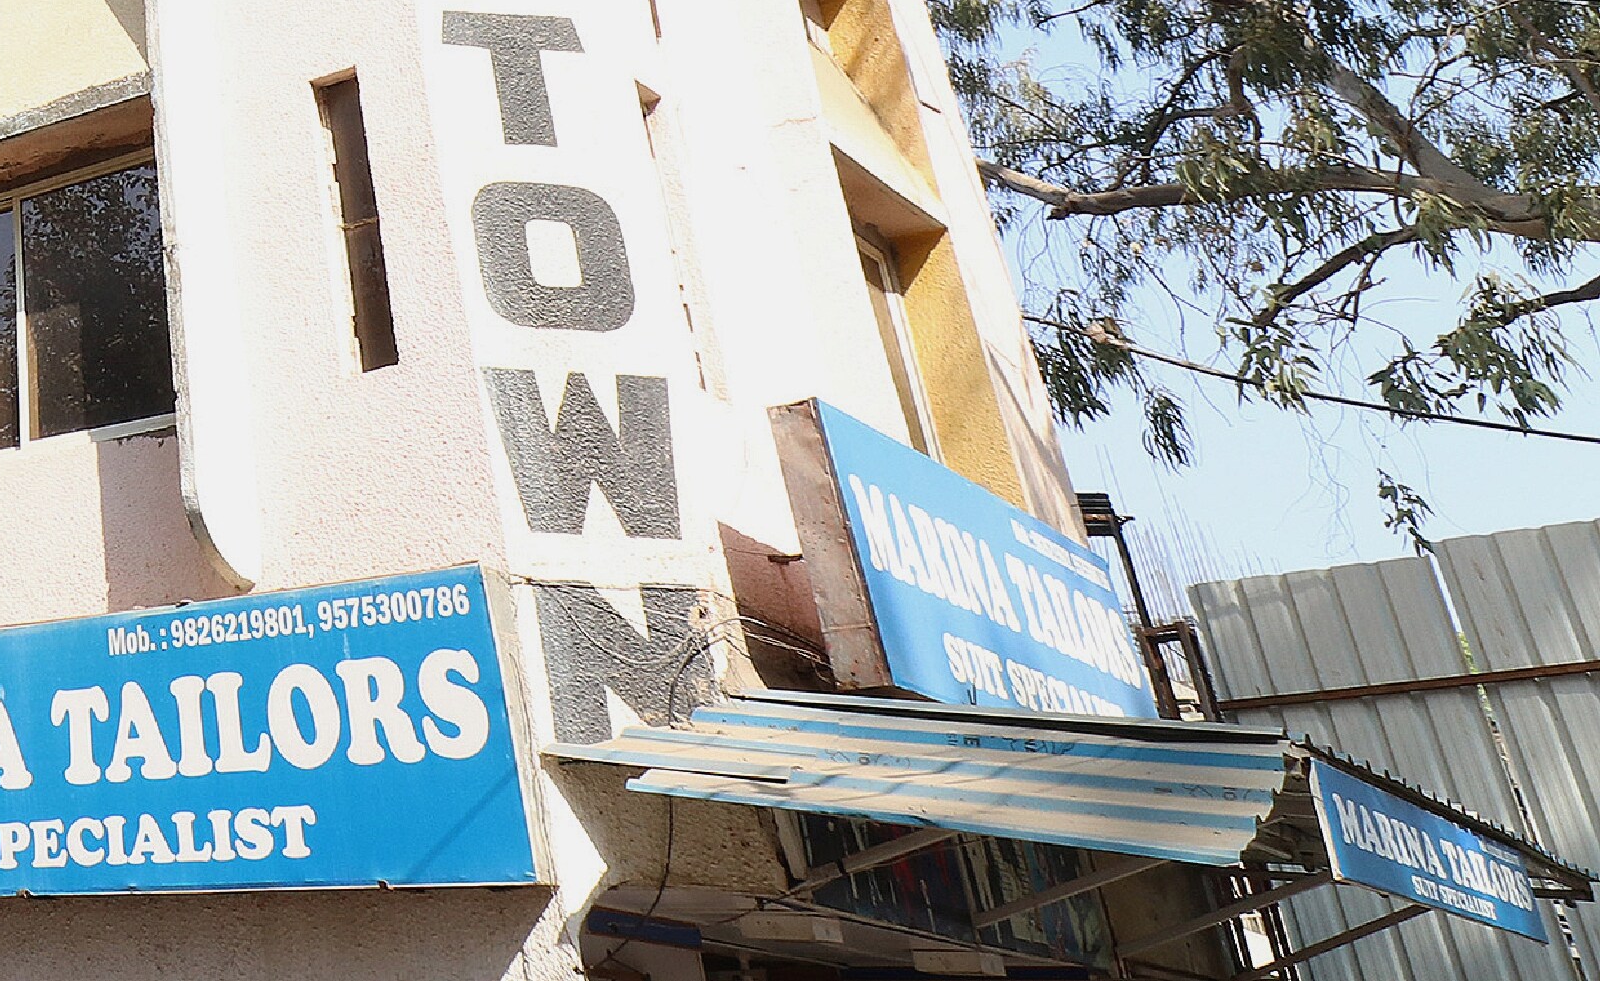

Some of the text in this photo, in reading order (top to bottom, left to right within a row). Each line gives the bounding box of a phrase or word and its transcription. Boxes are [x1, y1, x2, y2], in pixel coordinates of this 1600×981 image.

[171, 608, 314, 648] 9826219801,
[319, 583, 470, 631] 9575300786
[848, 473, 1021, 633] MARINA
[1005, 553, 1142, 689] TAILORS
[51, 648, 490, 785] TAILORS
[1331, 792, 1533, 912] MARINA TAILORS
